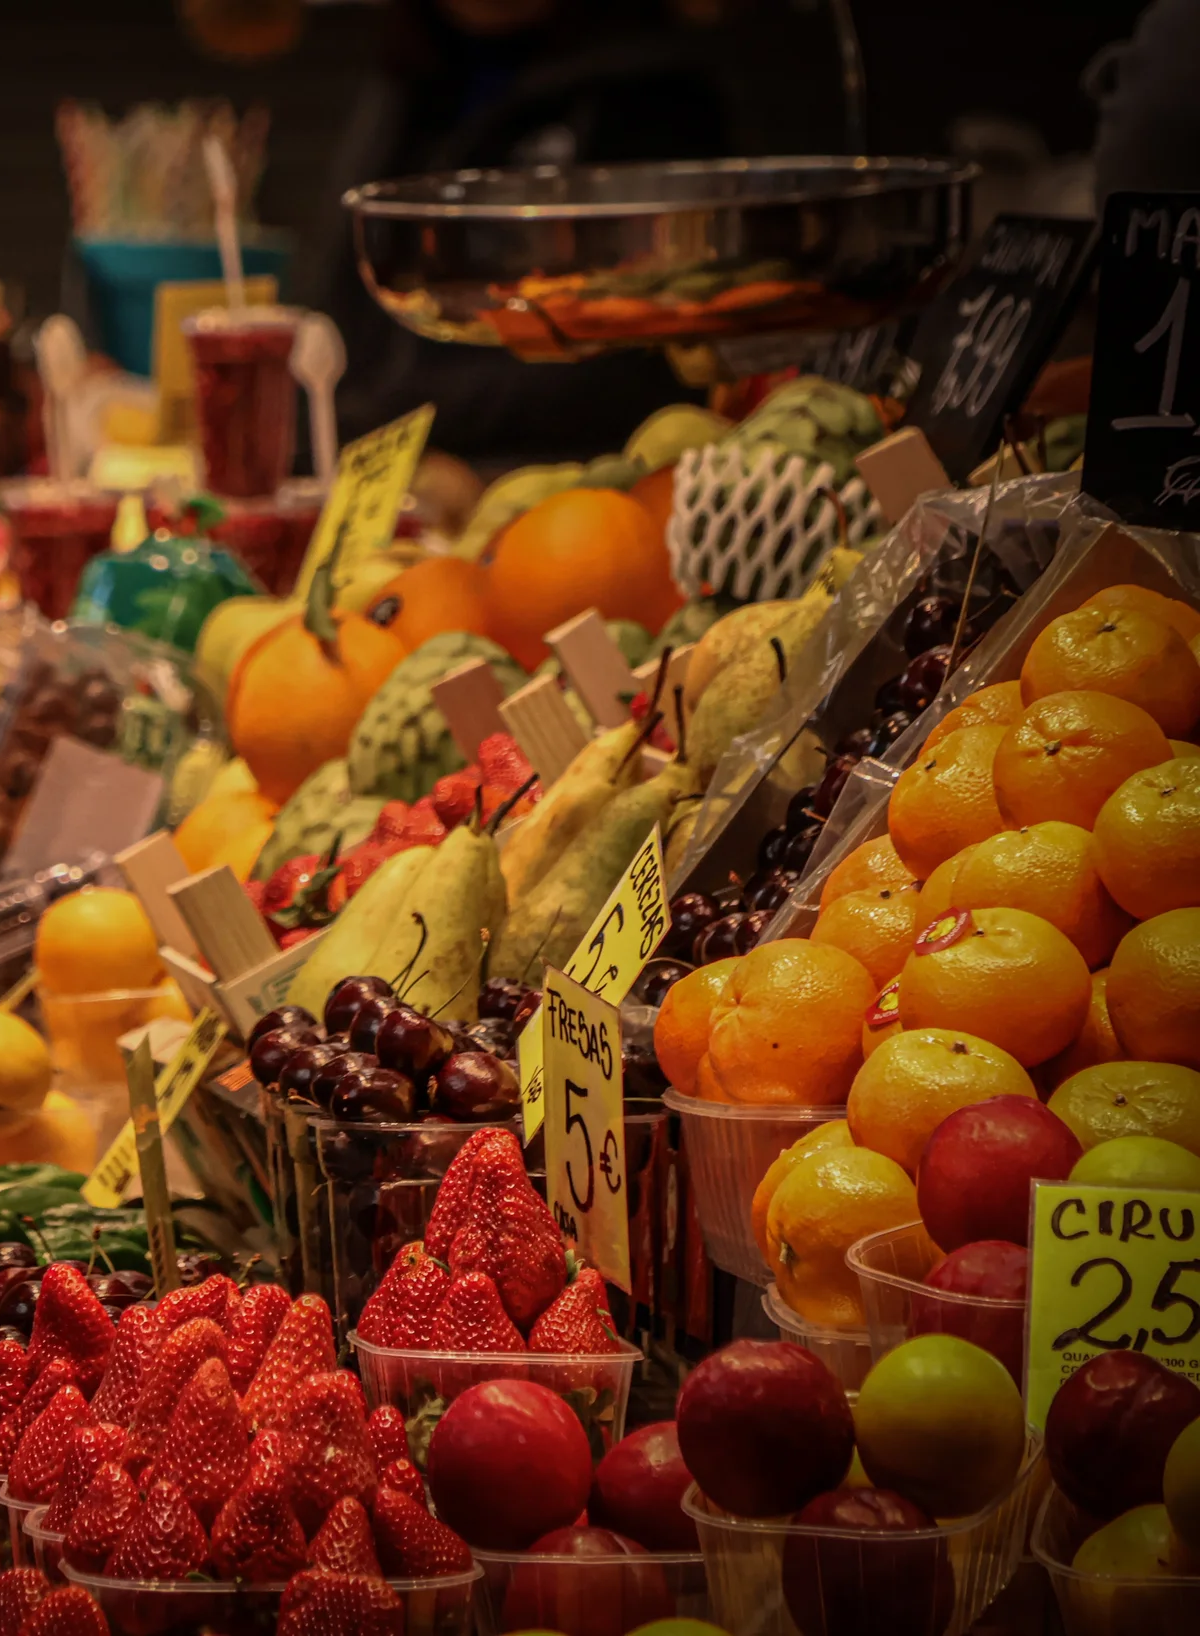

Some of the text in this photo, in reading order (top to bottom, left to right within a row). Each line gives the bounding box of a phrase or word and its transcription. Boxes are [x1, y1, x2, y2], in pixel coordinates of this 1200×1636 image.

[629, 841, 665, 960] CEREZAS
[546, 987, 613, 1081] FRESAS
[565, 1078, 595, 1214] 5
[1051, 1198, 1195, 1244] CIRU
[1051, 1256, 1200, 1352] 2,5
